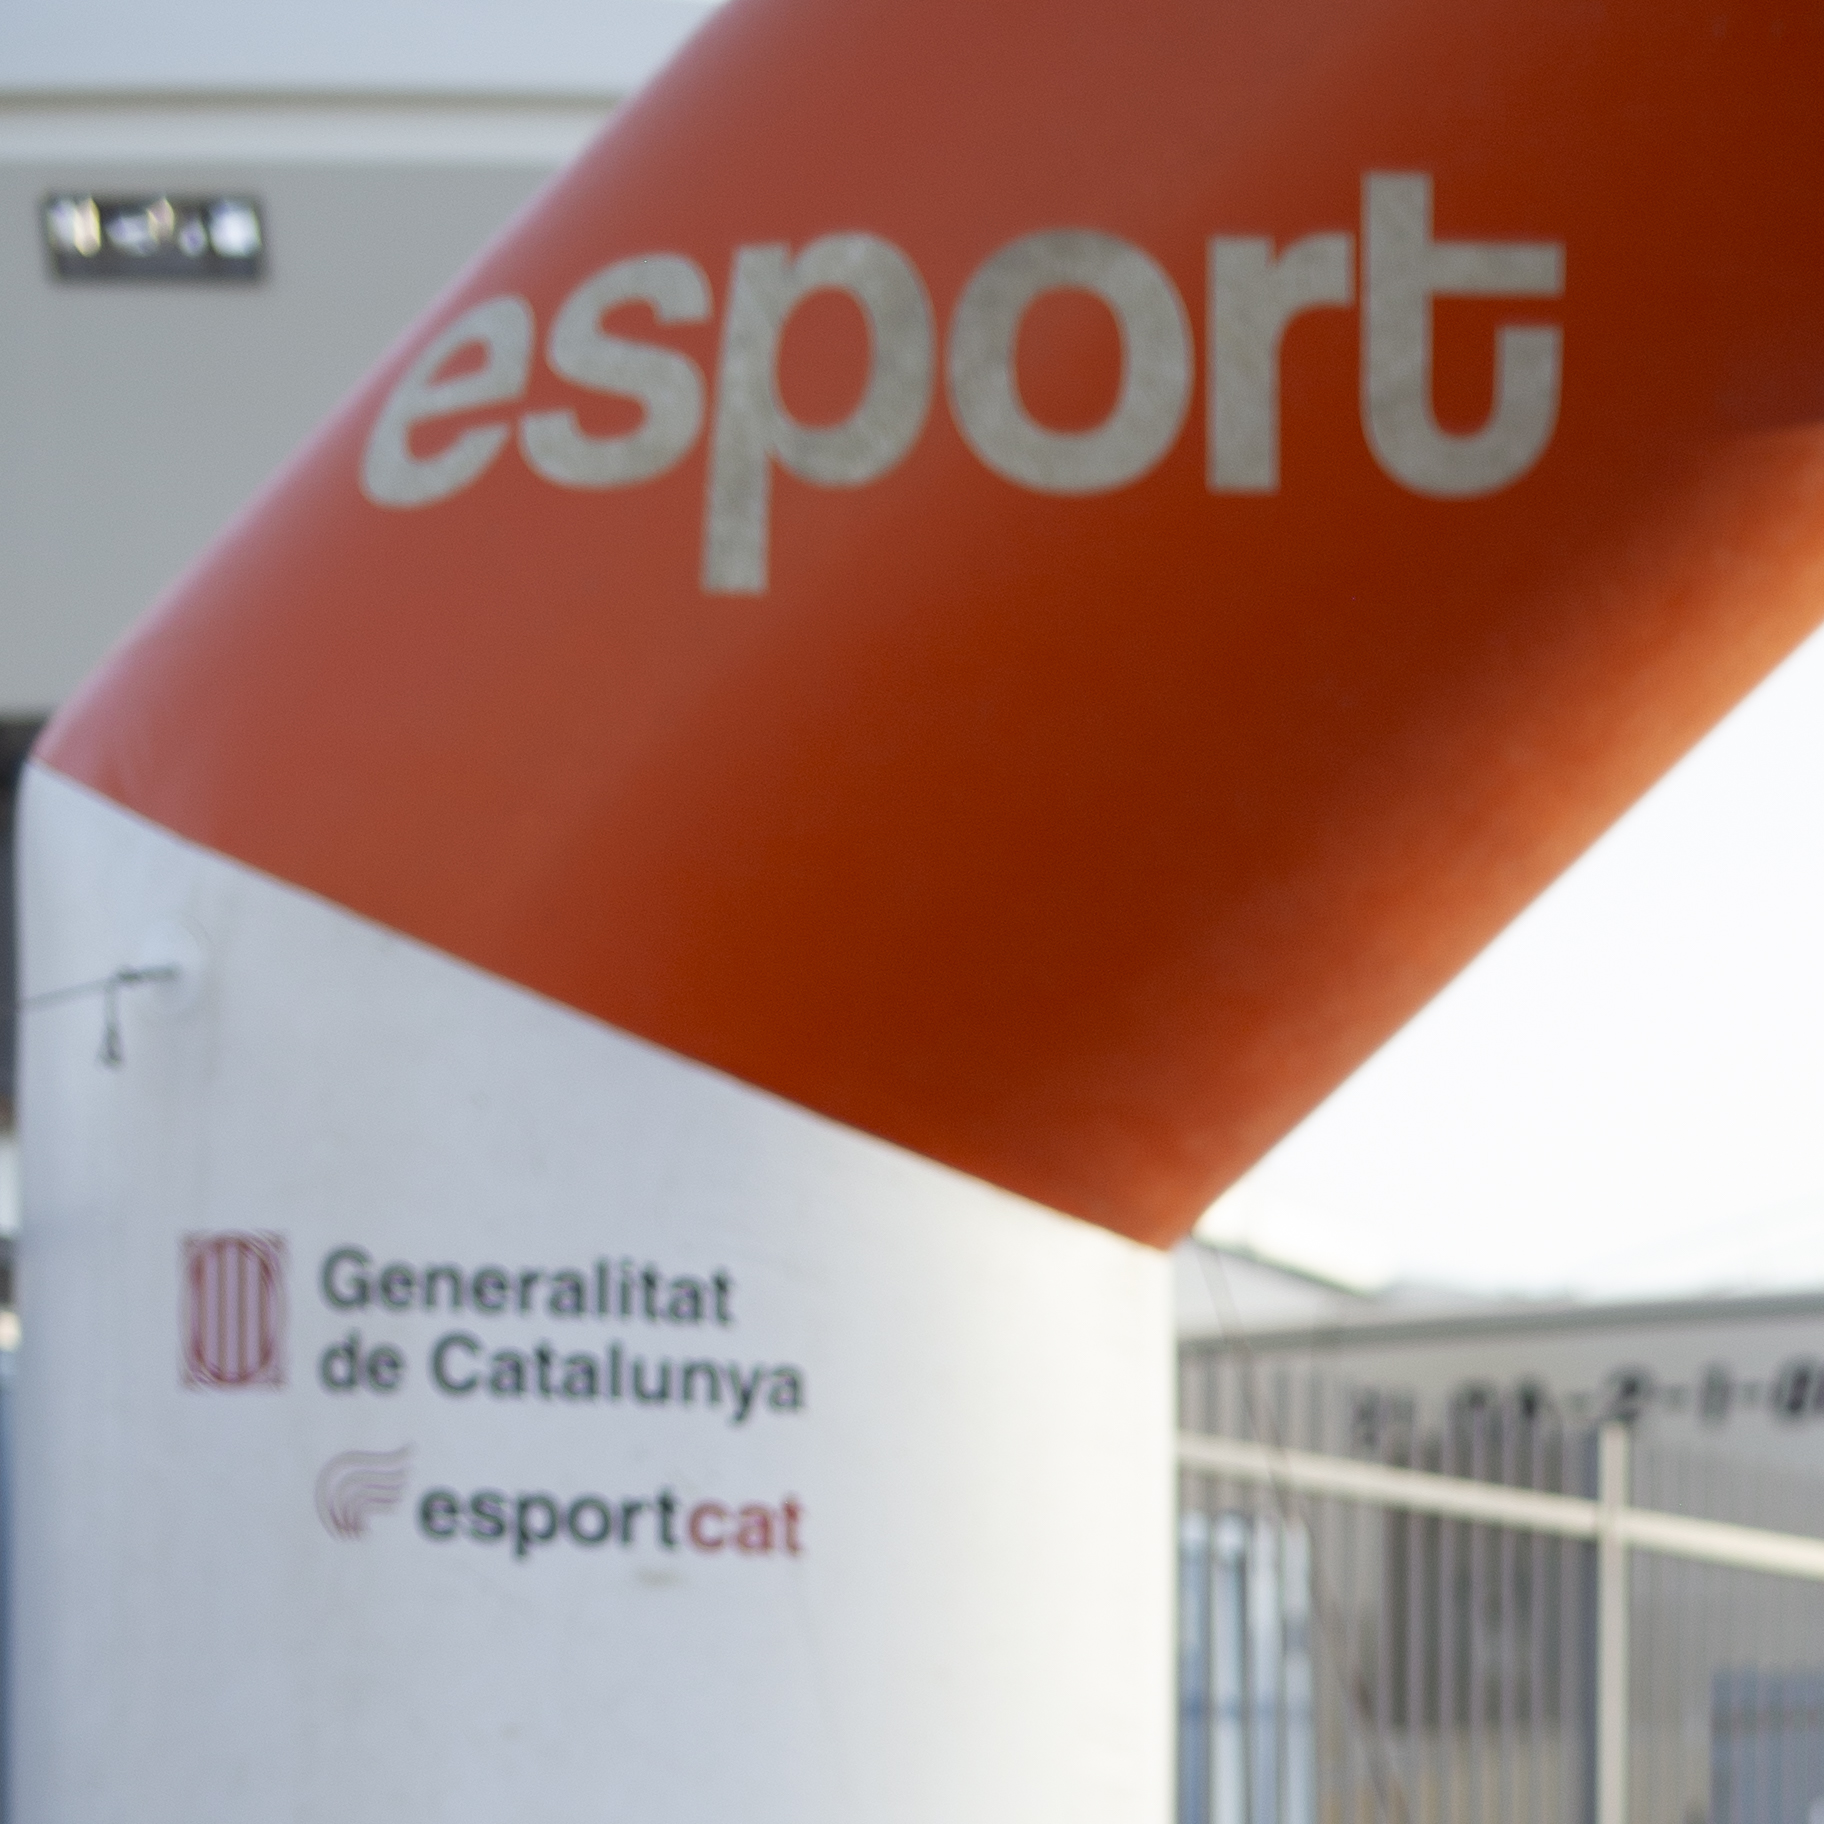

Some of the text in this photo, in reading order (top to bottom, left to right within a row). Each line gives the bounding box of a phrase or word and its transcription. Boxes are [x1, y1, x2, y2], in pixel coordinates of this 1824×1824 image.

[359, 169, 1568, 598] esport
[319, 1243, 735, 1327] Generalitat
[319, 1328, 806, 1425] de Catalunya
[416, 1482, 806, 1560] esportcat
